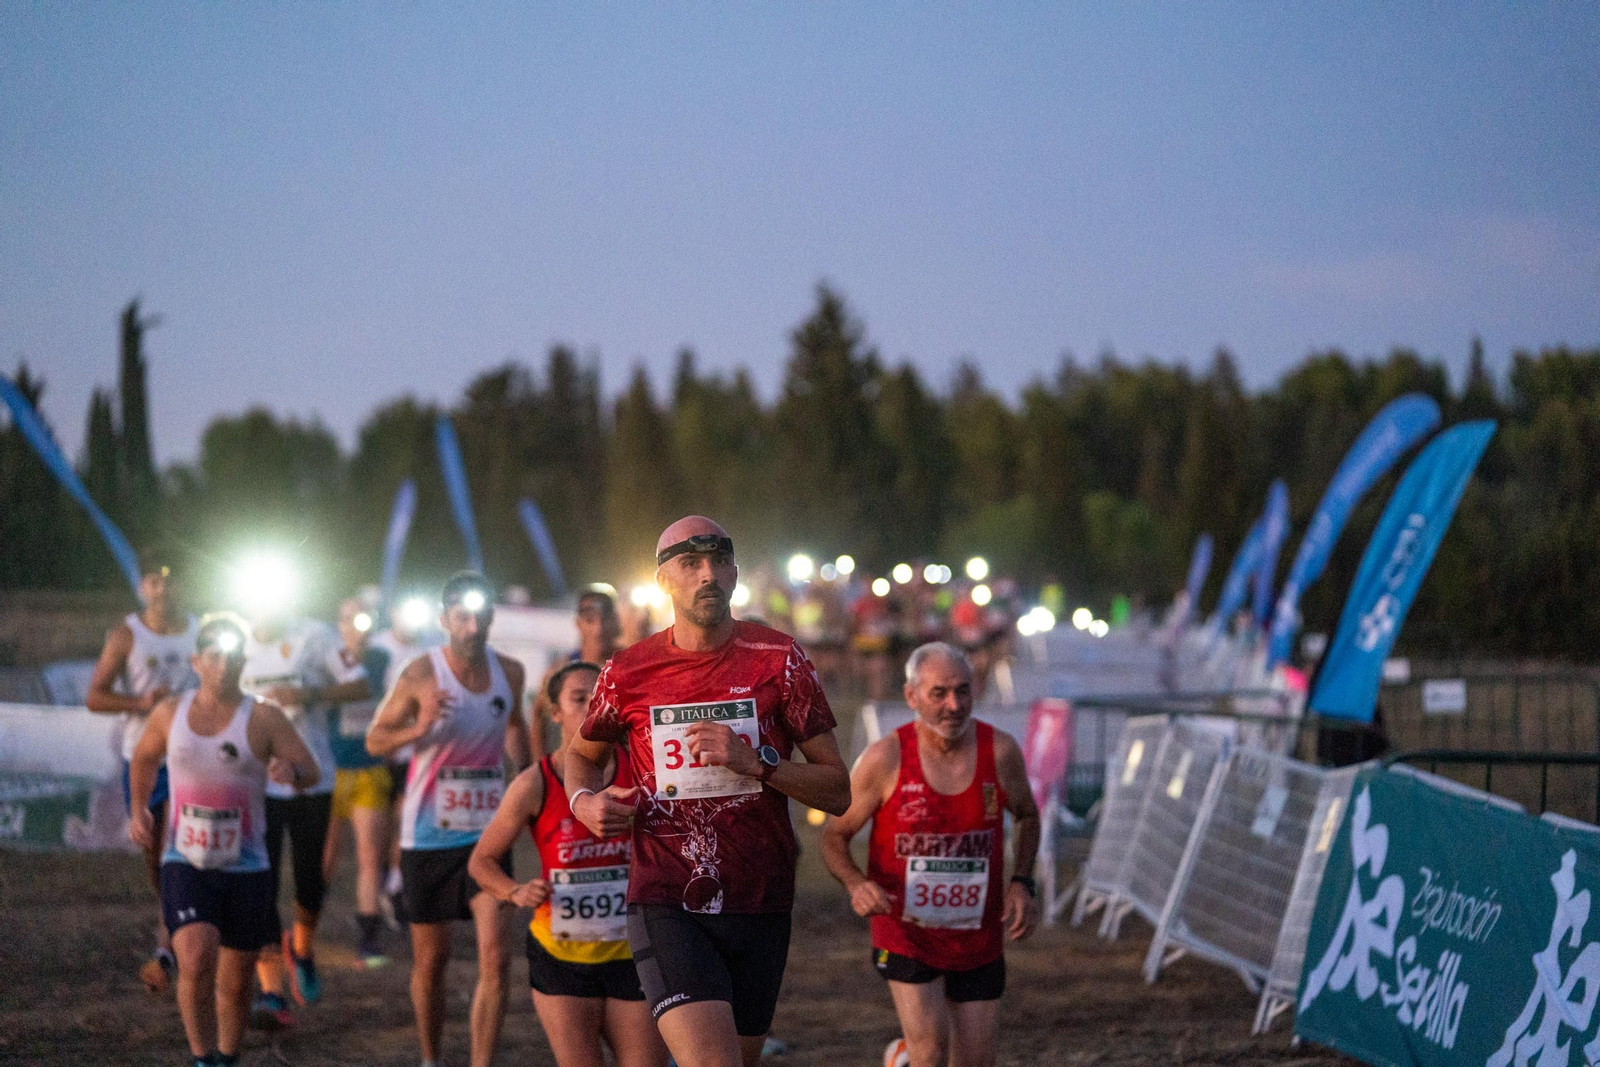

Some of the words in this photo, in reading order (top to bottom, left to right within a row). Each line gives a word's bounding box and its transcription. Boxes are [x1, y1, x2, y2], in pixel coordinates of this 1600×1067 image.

[730, 686, 751, 694] HOKA
[681, 706, 729, 720] ITÁLICA
[444, 788, 500, 811] 3416
[183, 826, 236, 849] 3417
[561, 892, 627, 919] 3692
[915, 883, 980, 908] 3688
[1380, 936, 1470, 1050] Sevilla
[651, 993, 690, 1017] LURBEL
